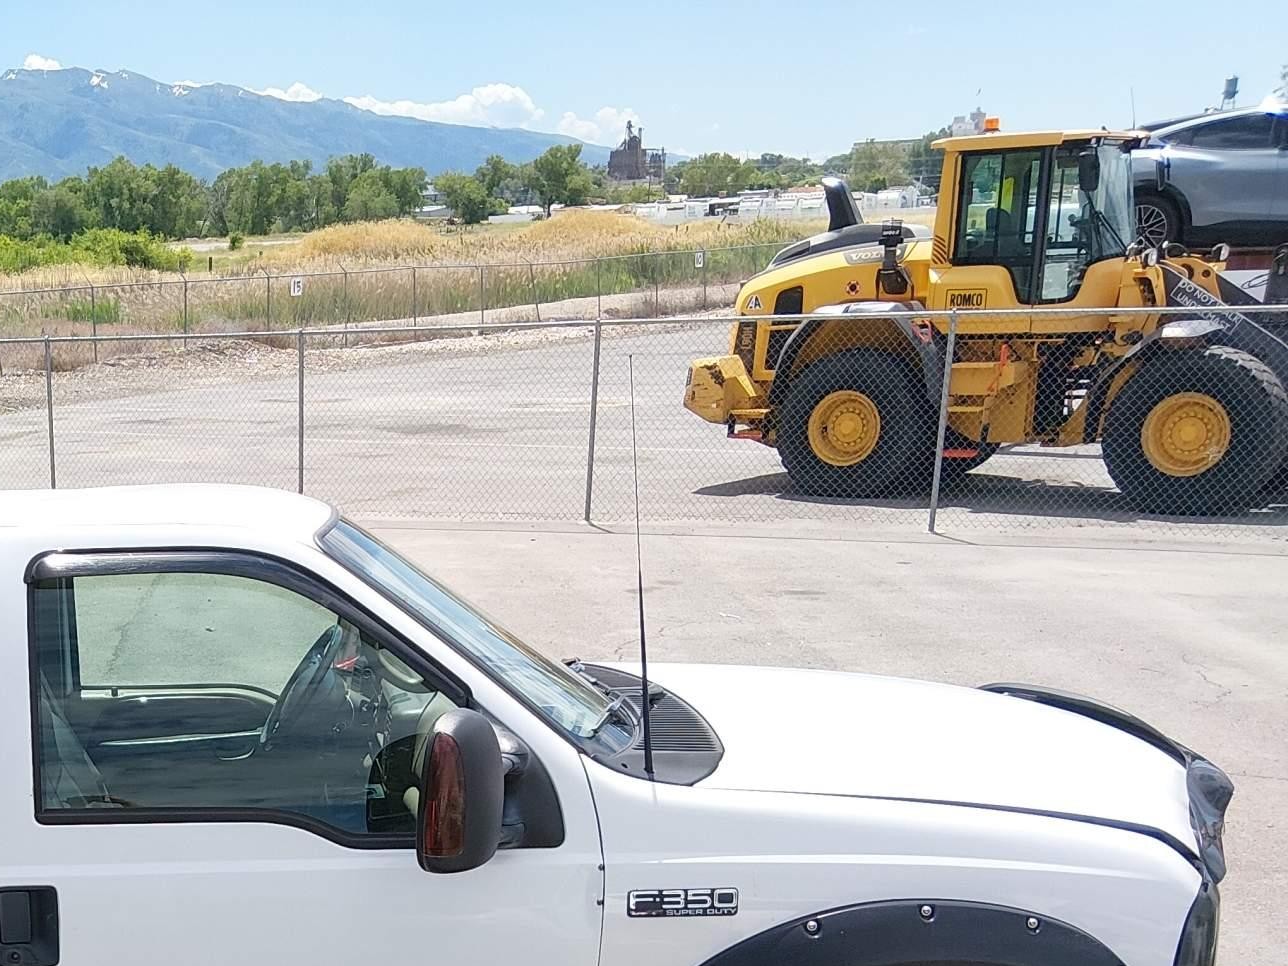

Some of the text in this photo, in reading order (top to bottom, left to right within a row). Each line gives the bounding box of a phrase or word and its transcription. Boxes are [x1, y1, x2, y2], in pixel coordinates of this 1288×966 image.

[293, 279, 301, 293] 15
[1180, 280, 1194, 293] DO
[1193, 289, 1215, 306] NOT
[950, 293, 983, 307] ROMCO
